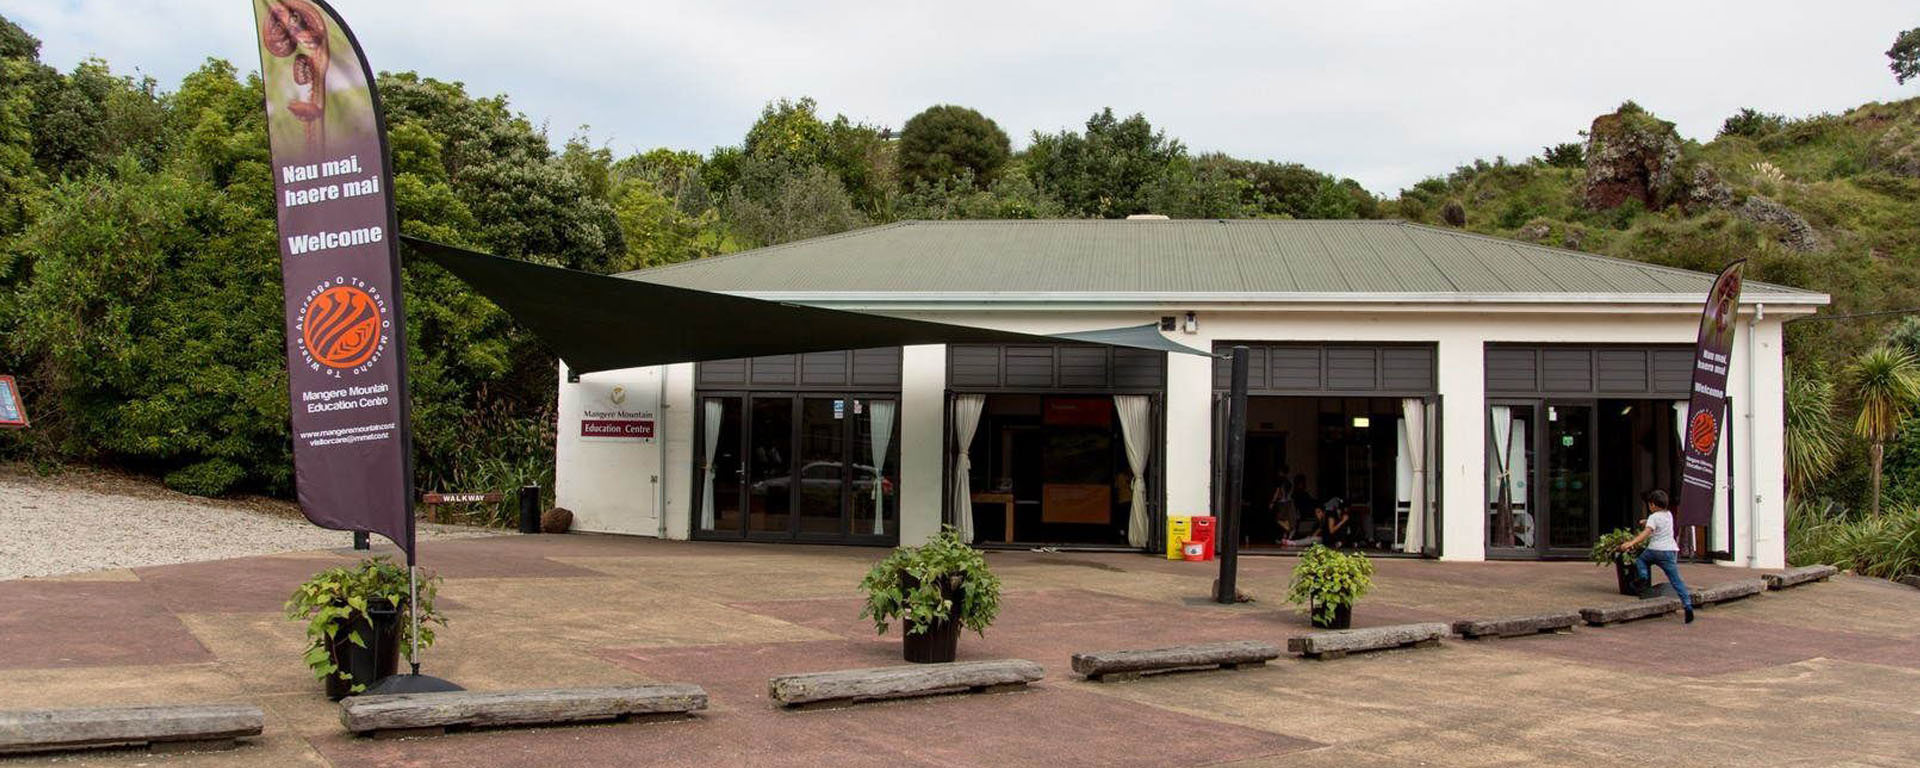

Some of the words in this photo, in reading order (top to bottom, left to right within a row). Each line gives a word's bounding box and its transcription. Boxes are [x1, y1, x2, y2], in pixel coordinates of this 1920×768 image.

[282, 164, 319, 184] Nau
[322, 155, 362, 177] mai,
[285, 184, 340, 207] haere
[343, 175, 379, 197] mai
[288, 226, 382, 255] Welcome
[303, 388, 347, 401] Mangere
[349, 383, 389, 396] Mountain
[307, 399, 358, 414] Education
[359, 395, 389, 409] Centre
[584, 410, 616, 419] Mangere
[617, 410, 653, 418] Mountain
[585, 424, 621, 433] Education
[625, 424, 651, 434] Centre
